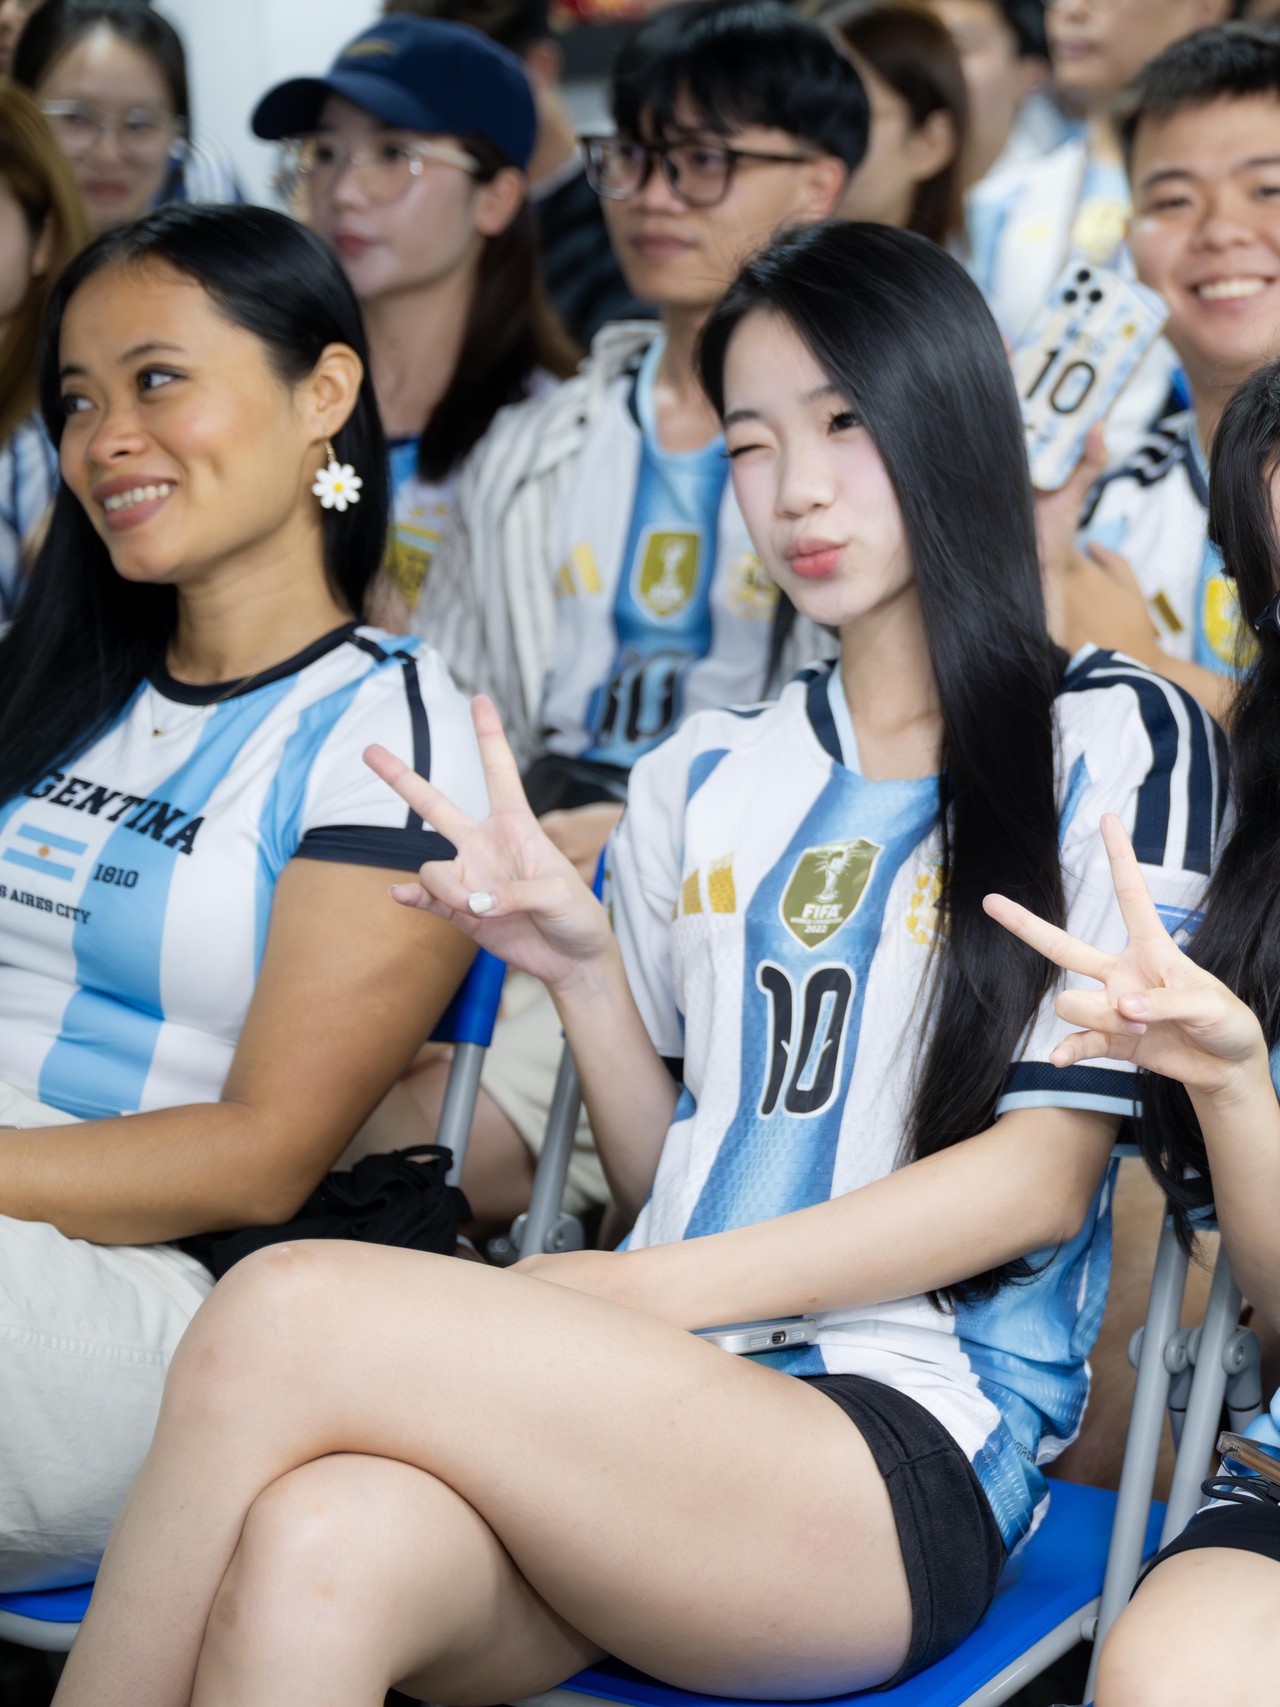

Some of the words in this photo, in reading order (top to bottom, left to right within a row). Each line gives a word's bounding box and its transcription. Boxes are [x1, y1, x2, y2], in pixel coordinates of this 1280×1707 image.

[1025, 350, 1096, 414] 10
[24, 771, 205, 856] GENTINA
[93, 863, 139, 889] 1810
[10, 889, 53, 912] AIRES
[56, 903, 92, 924] CITY
[802, 903, 840, 919] FIFA
[758, 962, 853, 1118] 10
